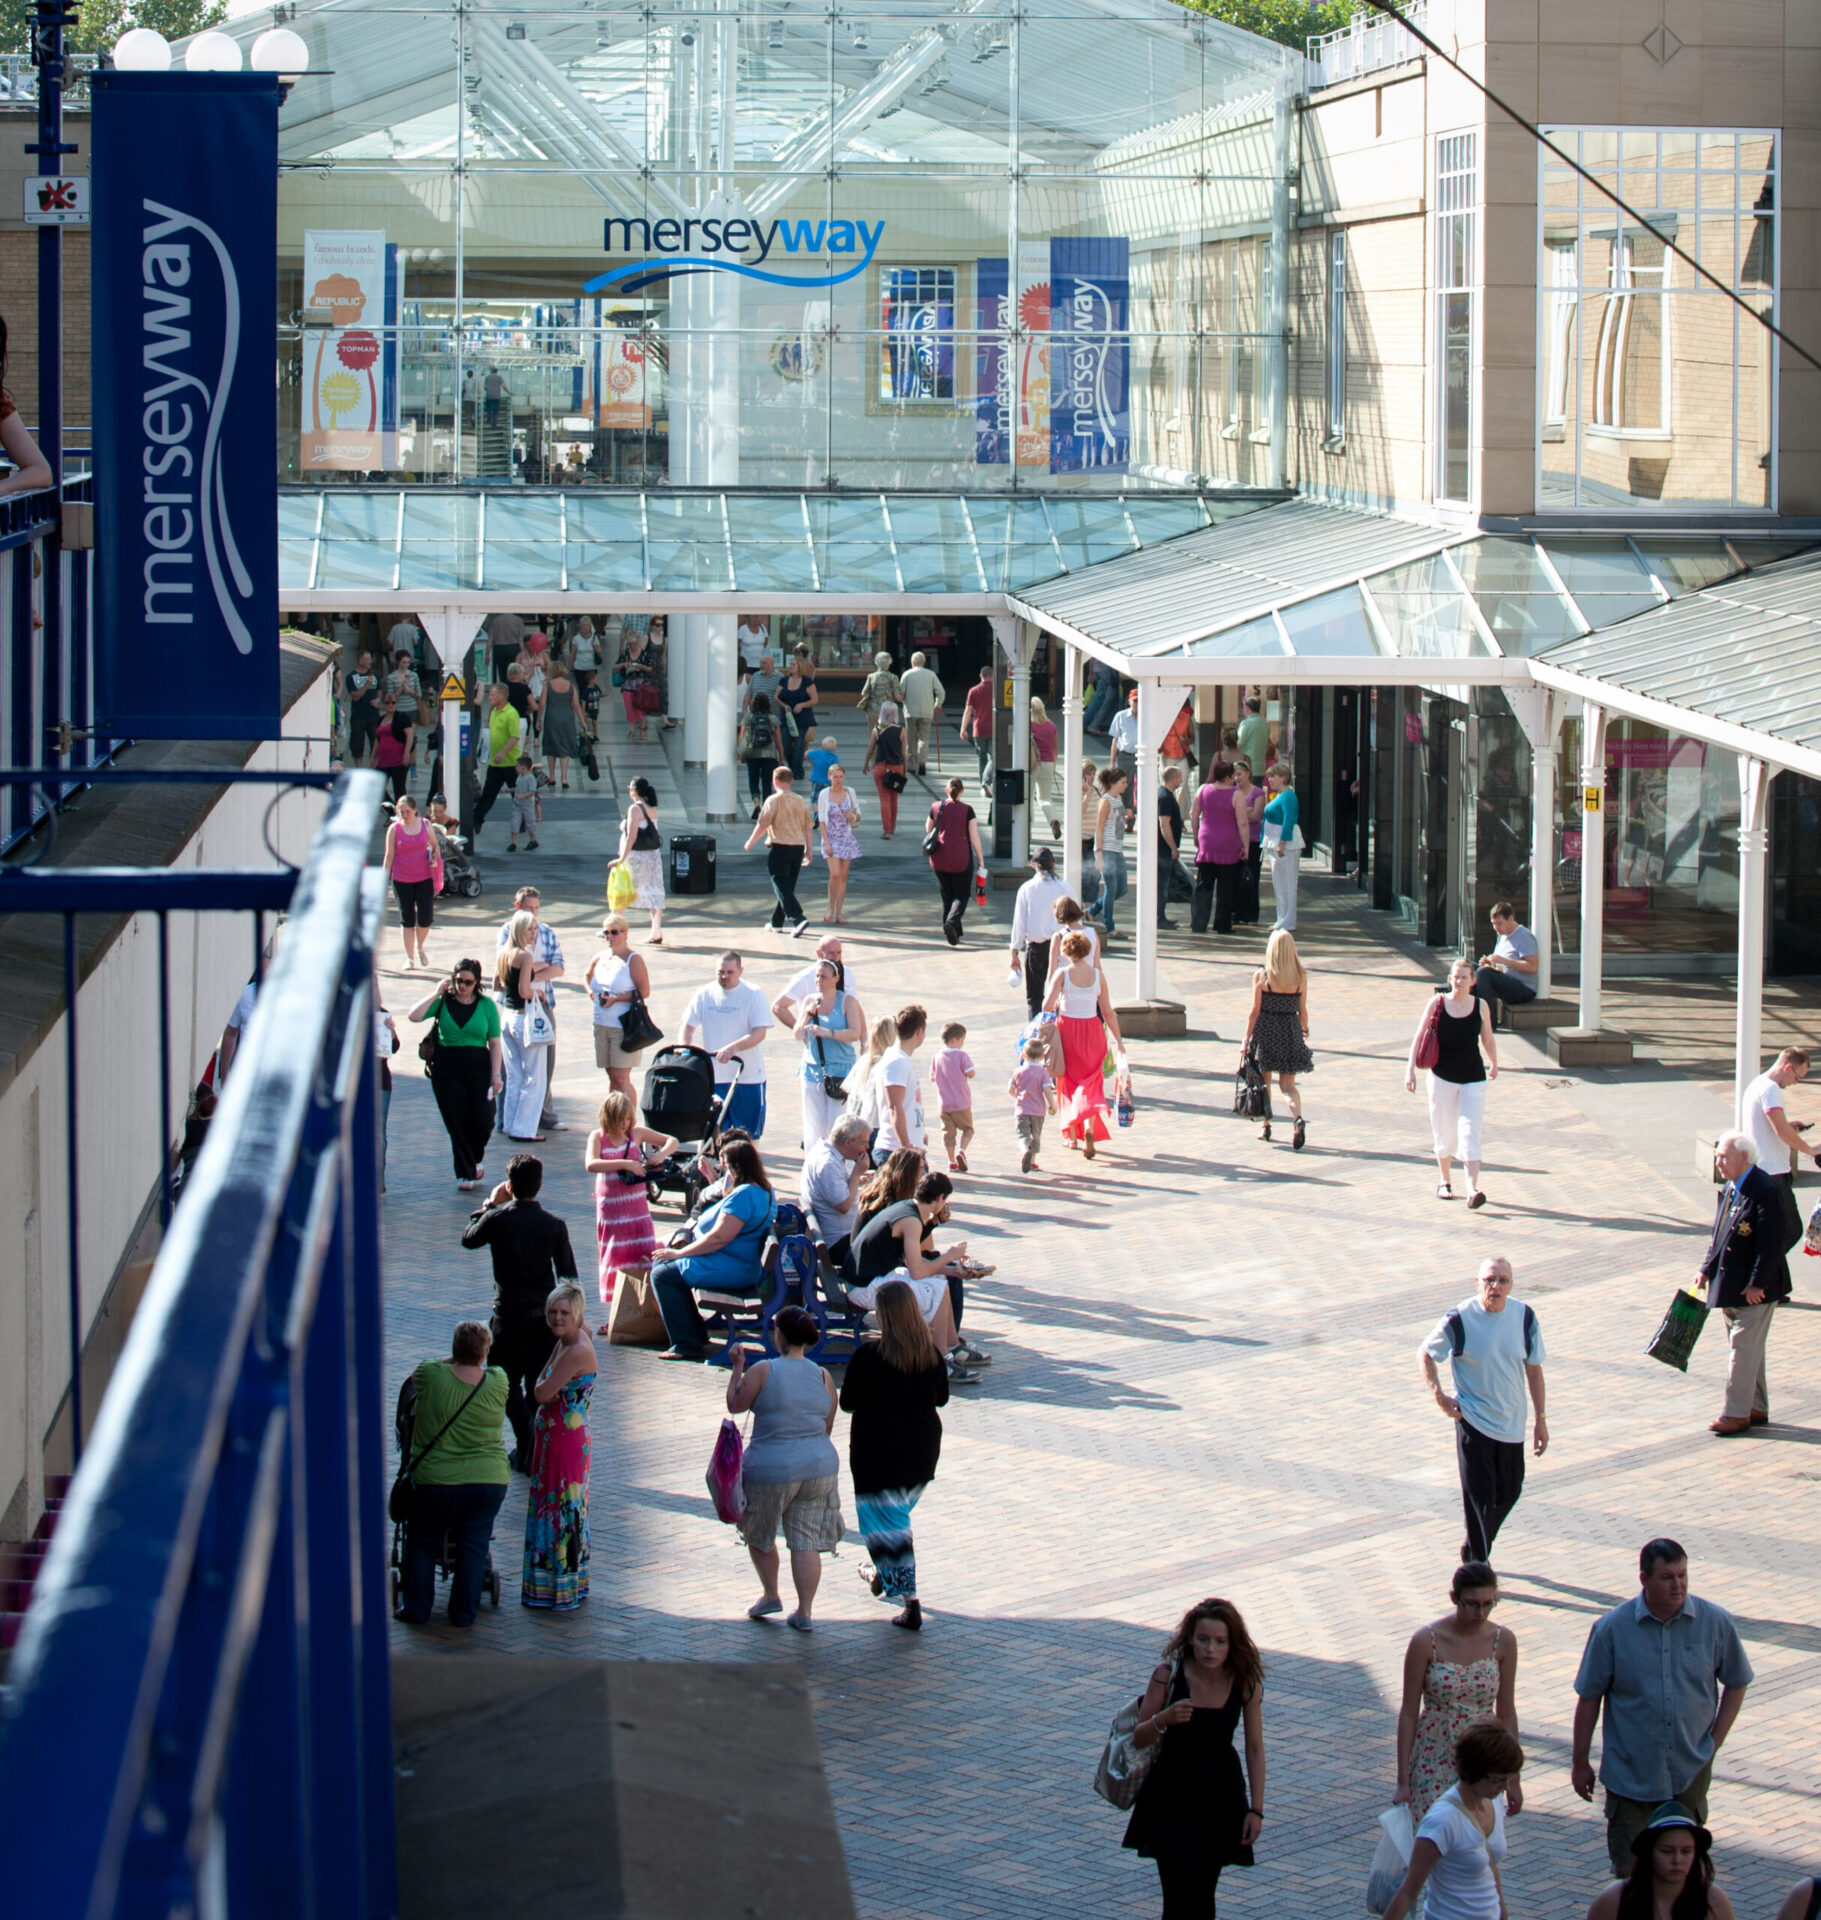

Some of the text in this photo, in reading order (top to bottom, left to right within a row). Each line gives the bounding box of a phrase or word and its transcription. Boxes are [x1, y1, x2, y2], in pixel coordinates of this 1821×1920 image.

[314, 243, 344, 253] famous
[604, 217, 886, 266] merseyway
[315, 296, 360, 306] REPUBLIC
[341, 345, 375, 353] TOPMAN
[1073, 278, 1101, 437] merseyway
[143, 198, 213, 624] merseyway
[314, 445, 373, 457] merseyway
[1586, 790, 1599, 809] H
